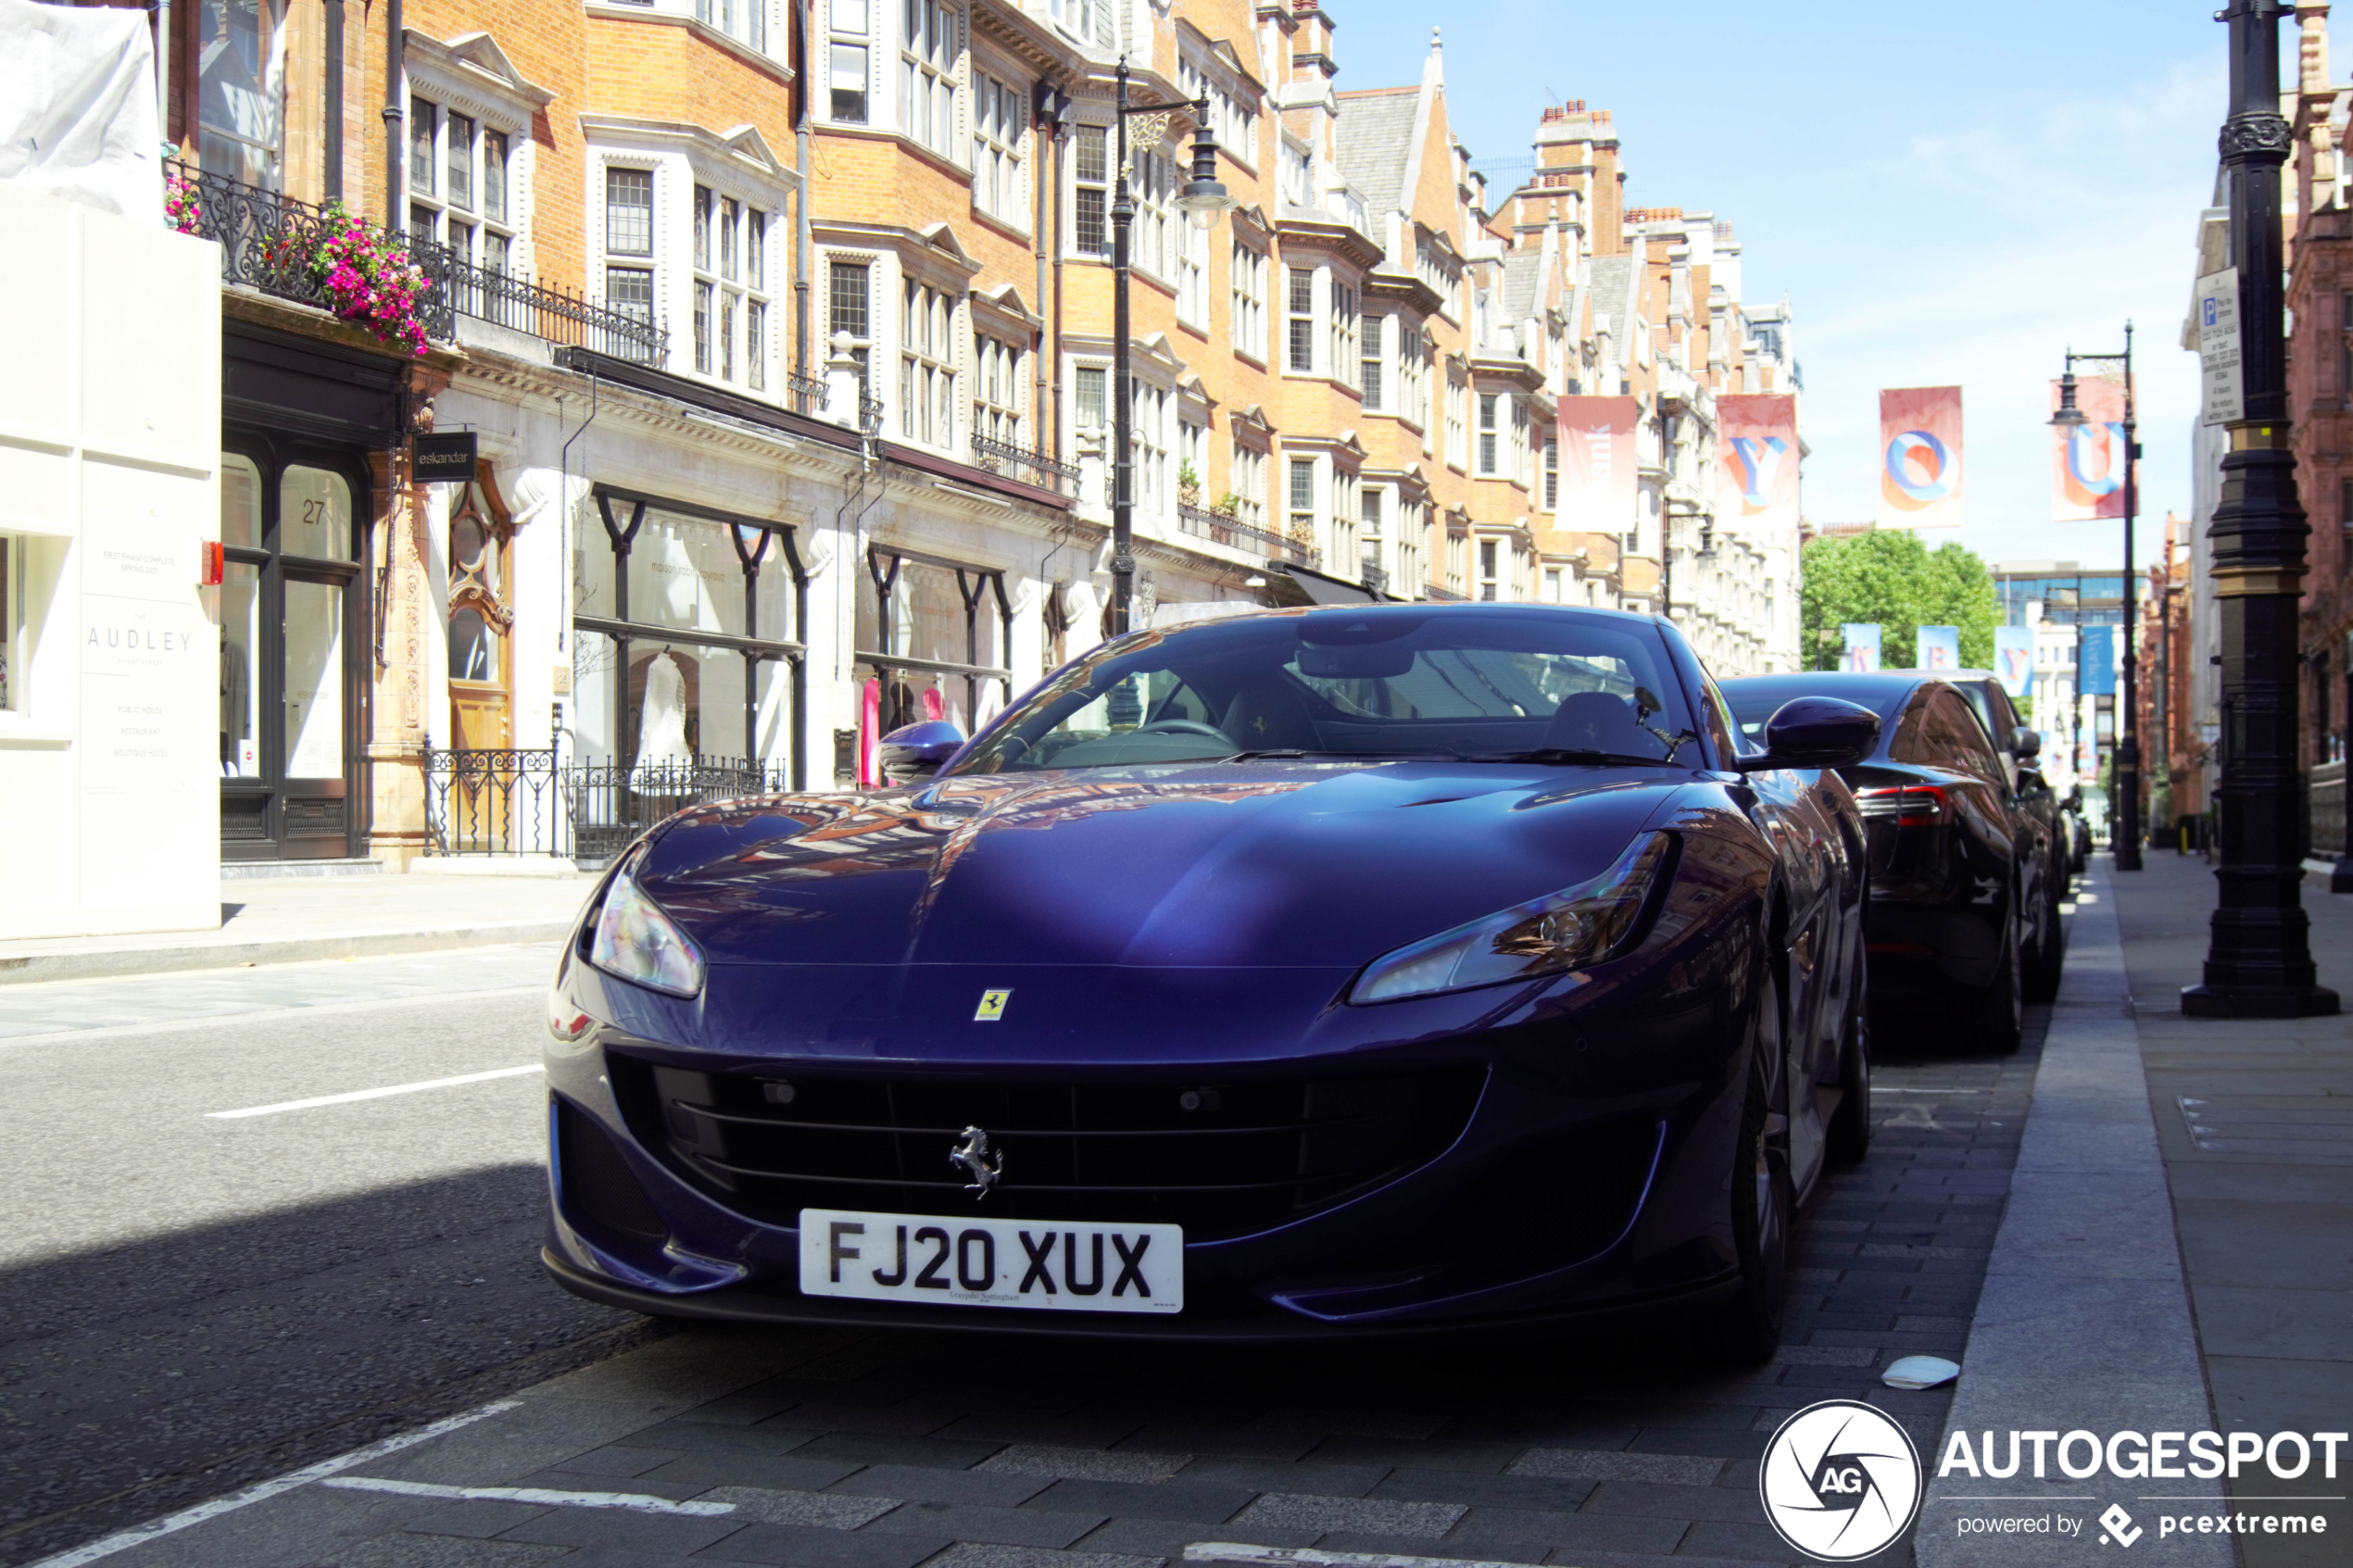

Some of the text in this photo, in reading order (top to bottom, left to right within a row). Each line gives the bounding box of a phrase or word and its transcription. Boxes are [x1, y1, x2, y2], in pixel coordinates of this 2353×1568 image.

[419, 450, 469, 465] eskandar
[1727, 435, 1788, 513] Y
[302, 499, 324, 525] 27
[103, 550, 175, 566] FIRST PHASE COMPLETE
[120, 564, 145, 574] SPRING
[651, 560, 677, 575] maison
[698, 566, 725, 583] kayrouz
[87, 626, 191, 652] AUDLEY
[296, 688, 330, 701] eskandar
[118, 705, 163, 715] PUBLIC HOUSE
[120, 727, 161, 736] RESTAURANT
[113, 748, 169, 758] BOUTIQUE HOTEL
[829, 1221, 1151, 1298] FJ20 XUX
[981, 1291, 1020, 1302] Nottingham
